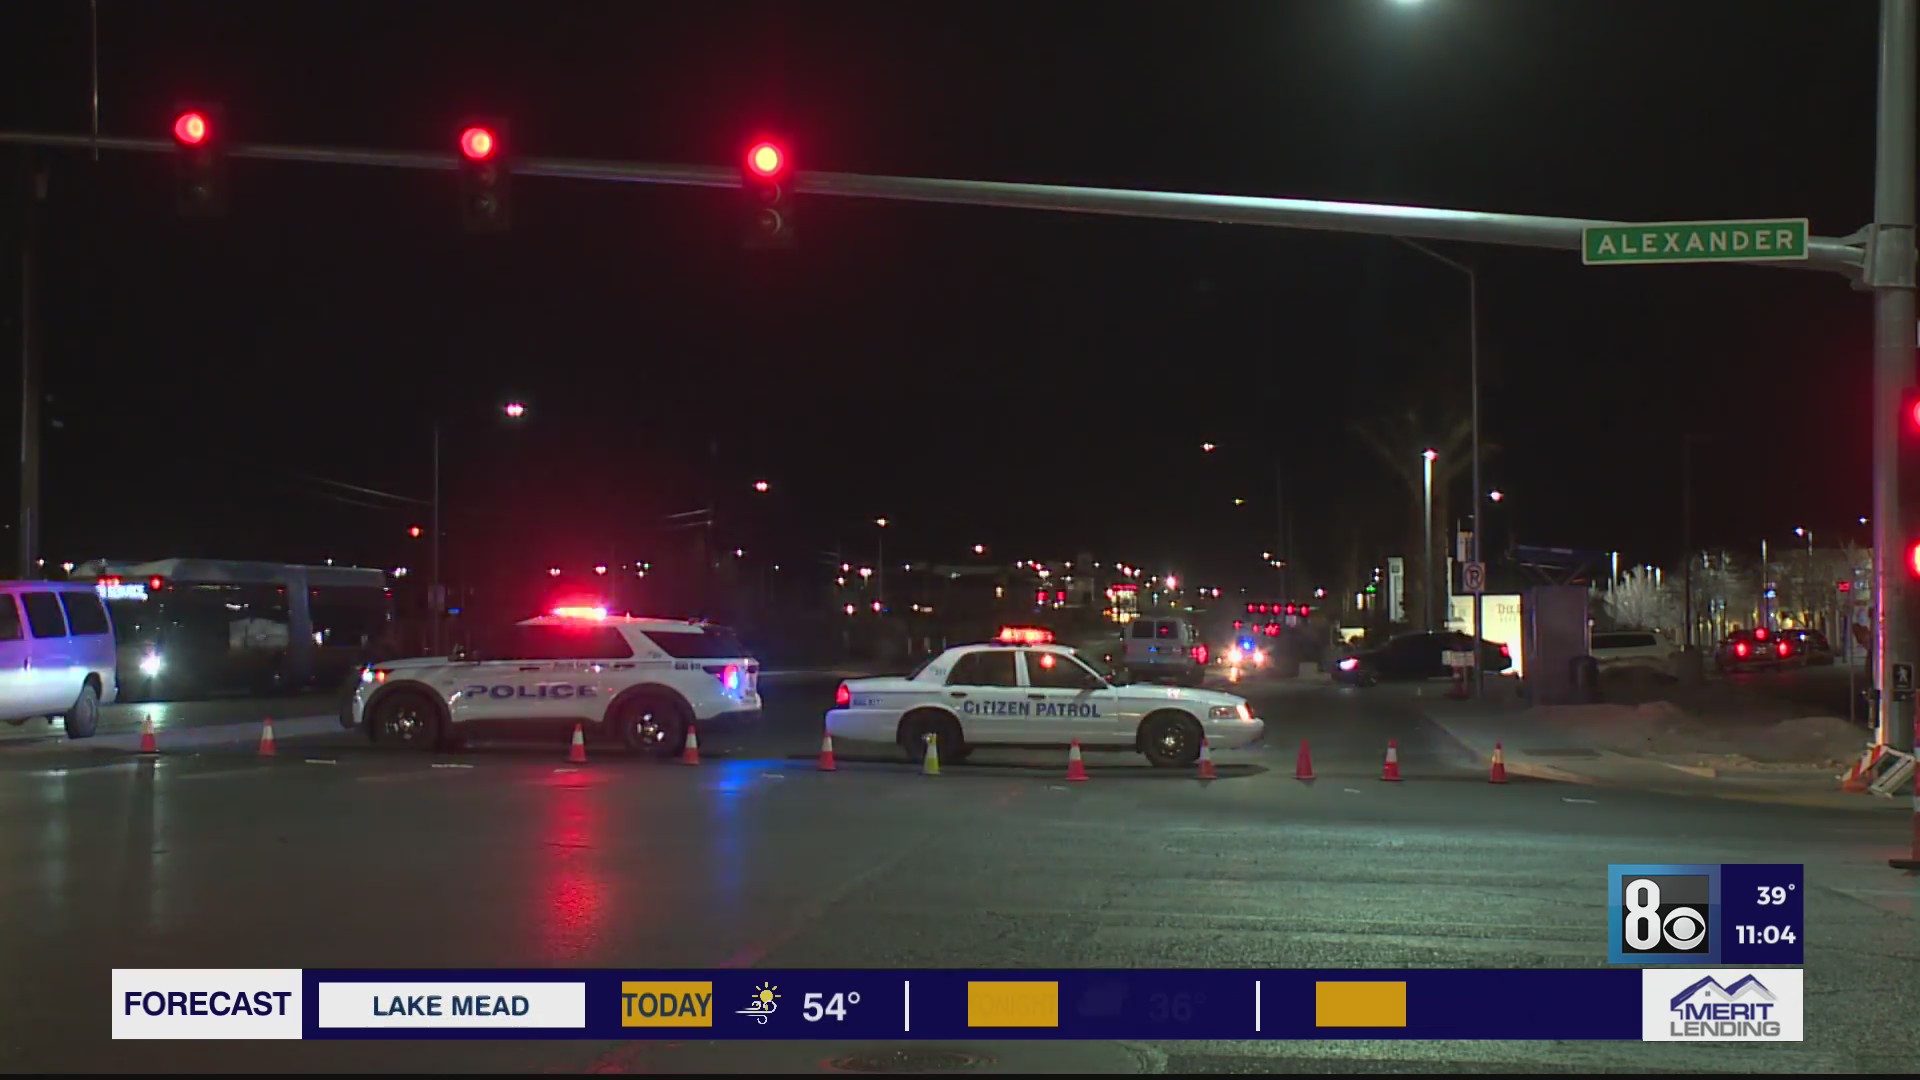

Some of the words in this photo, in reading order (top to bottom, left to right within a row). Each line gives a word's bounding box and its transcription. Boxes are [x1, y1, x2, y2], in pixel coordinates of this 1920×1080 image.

[1597, 230, 1794, 255] ALEXANDER
[466, 684, 598, 699] POLICE
[963, 700, 1030, 717] CITIZEN
[1035, 700, 1101, 718] PATROL
